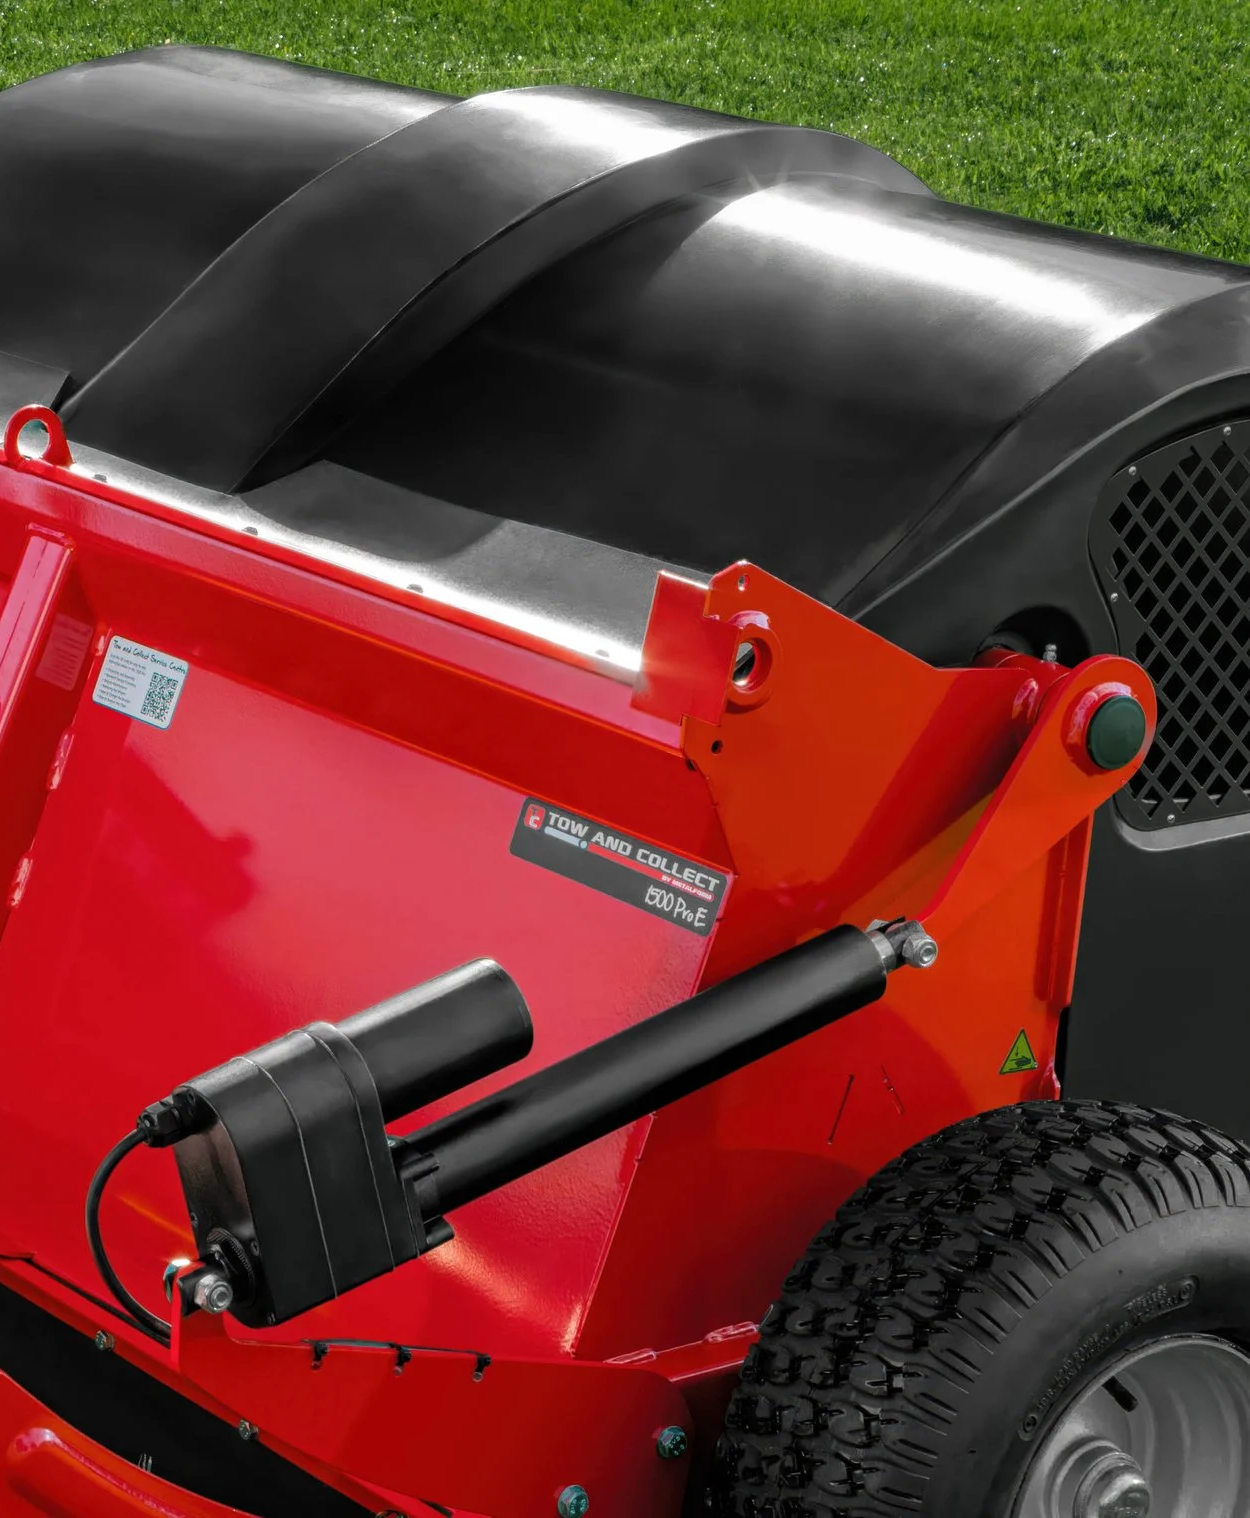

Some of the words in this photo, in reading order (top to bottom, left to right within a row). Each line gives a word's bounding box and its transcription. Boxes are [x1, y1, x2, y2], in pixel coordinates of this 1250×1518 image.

[548, 811, 589, 838] TOW
[590, 831, 632, 856] AND
[636, 848, 720, 893] COLLECT
[644, 884, 674, 912] 1500
[661, 874, 671, 883] BY
[672, 878, 713, 901] METALFORM
